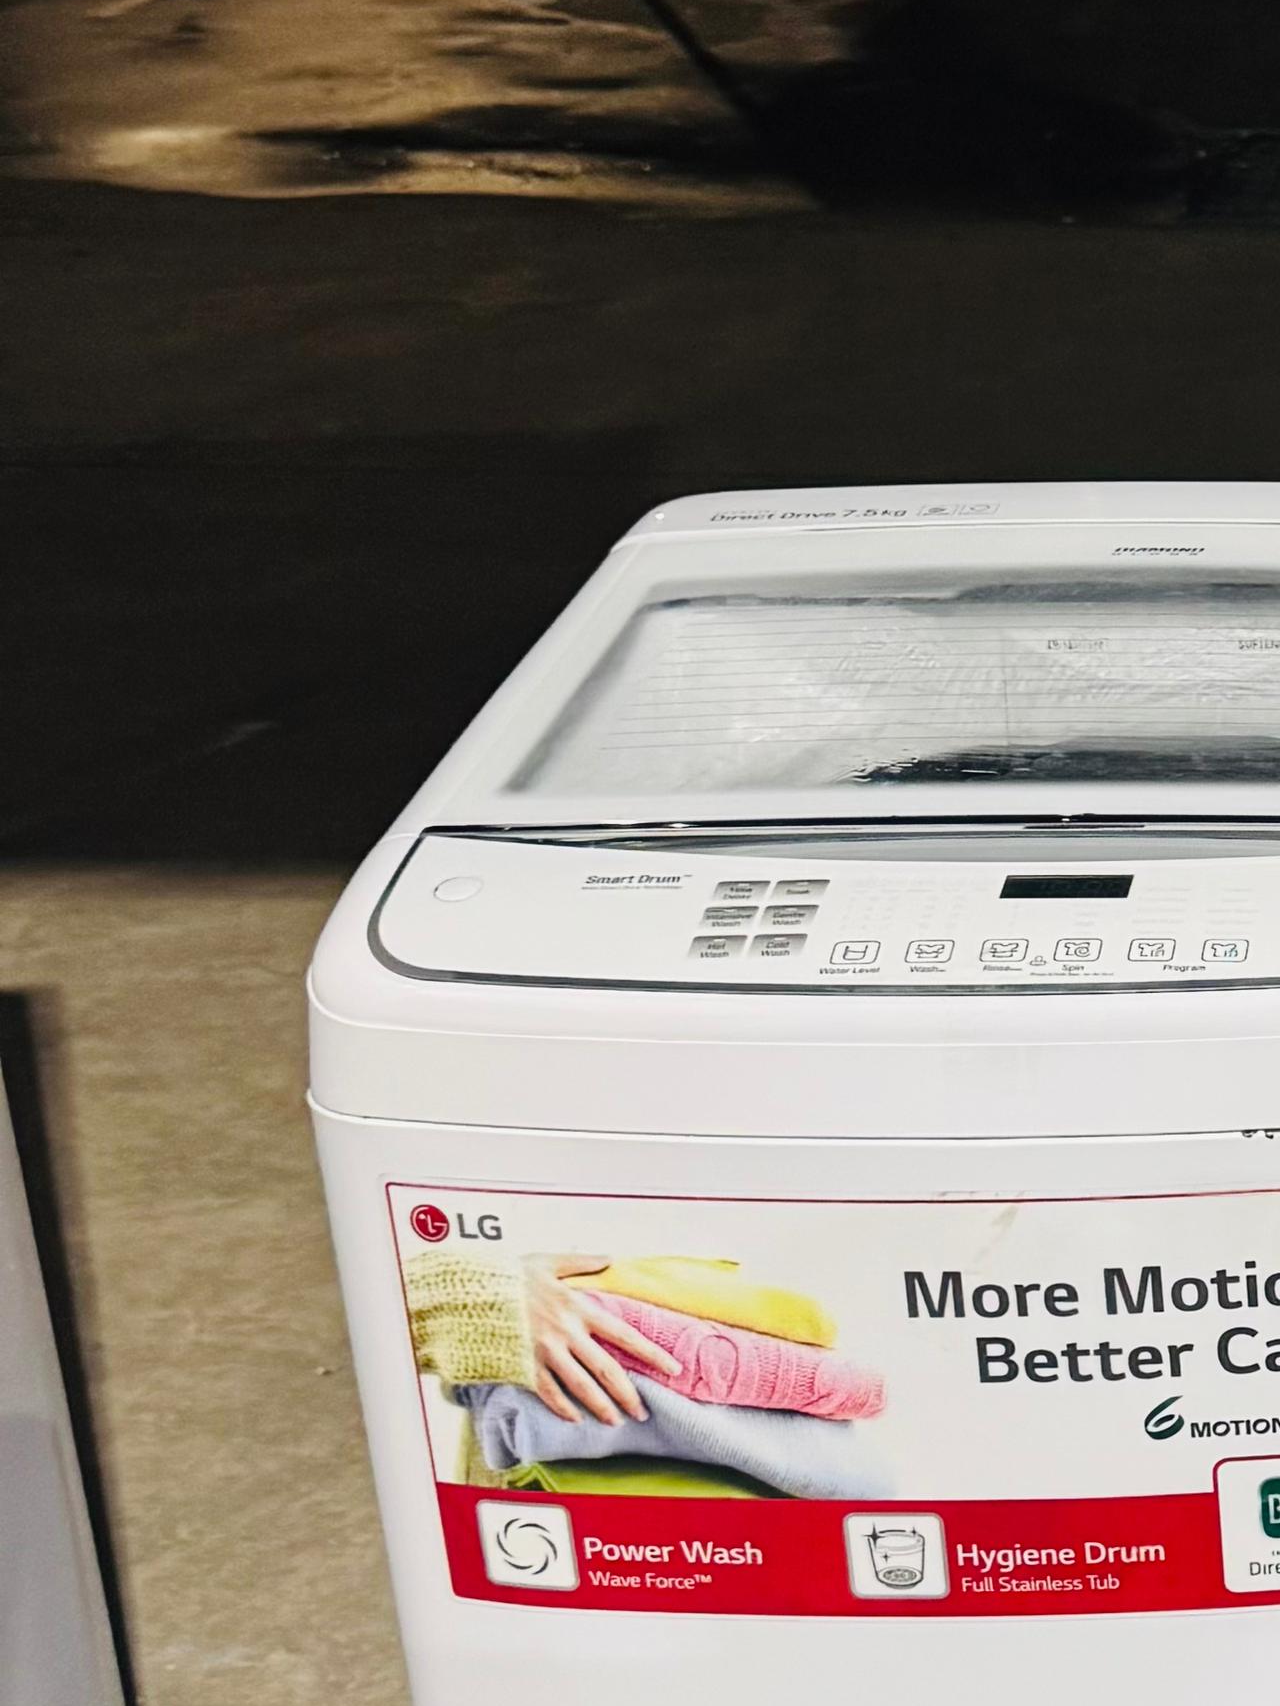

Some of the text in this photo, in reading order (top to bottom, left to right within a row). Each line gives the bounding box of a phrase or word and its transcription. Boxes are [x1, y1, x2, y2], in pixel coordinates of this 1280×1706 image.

[584, 875, 635, 884] Smart
[456, 1213, 503, 1241] LG
[904, 1270, 1079, 1319] More
[976, 1336, 1195, 1384] Better
[583, 1537, 763, 1565] Power Wash
[956, 1541, 1166, 1573] Hygiene Drum
[588, 1570, 641, 1588] Wave
[961, 1573, 1121, 1593] Full Stainless Tub
